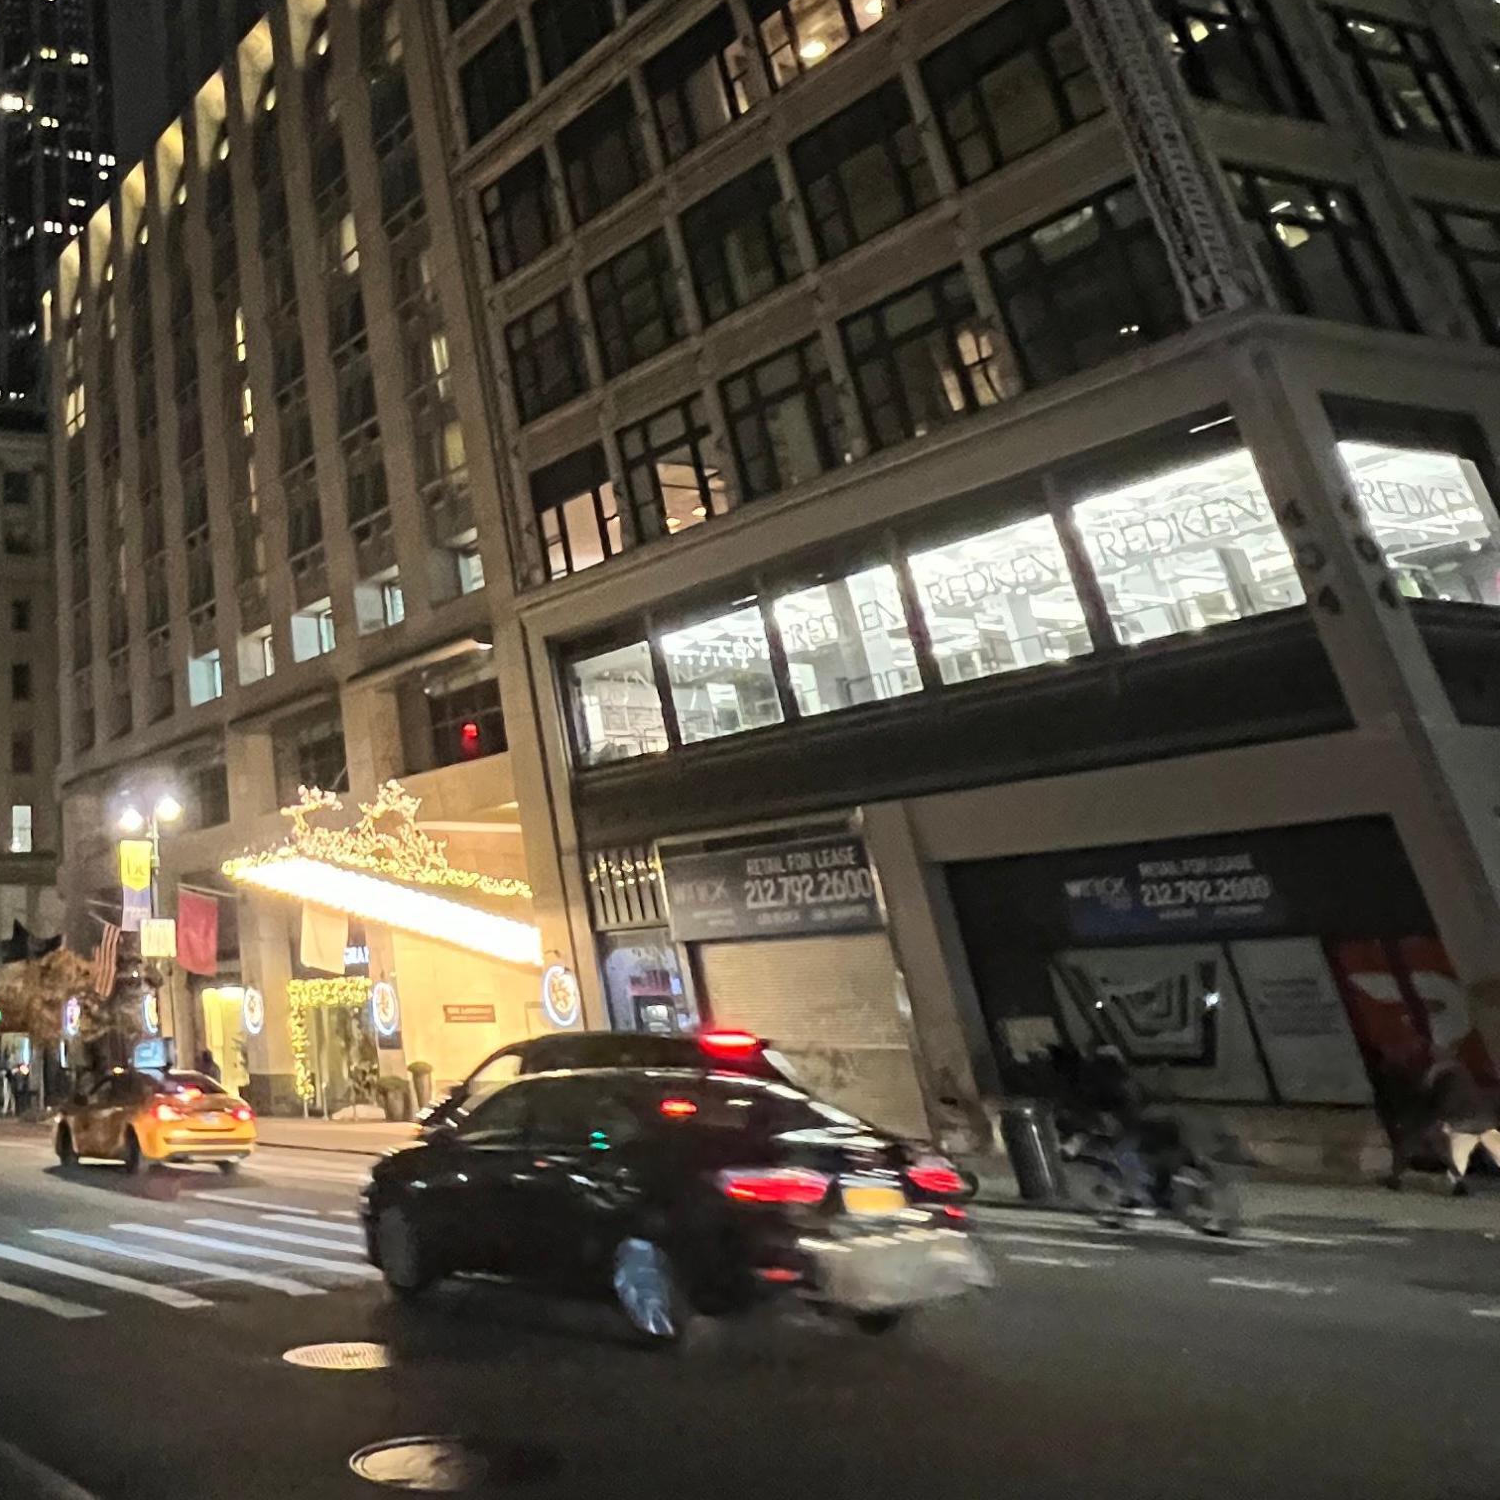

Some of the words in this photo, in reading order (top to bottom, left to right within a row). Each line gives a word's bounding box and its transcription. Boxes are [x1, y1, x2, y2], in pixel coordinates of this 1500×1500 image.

[1095, 490, 1270, 567] REDKEN
[926, 554, 1061, 609] REDKEN
[815, 845, 856, 869] LEASE
